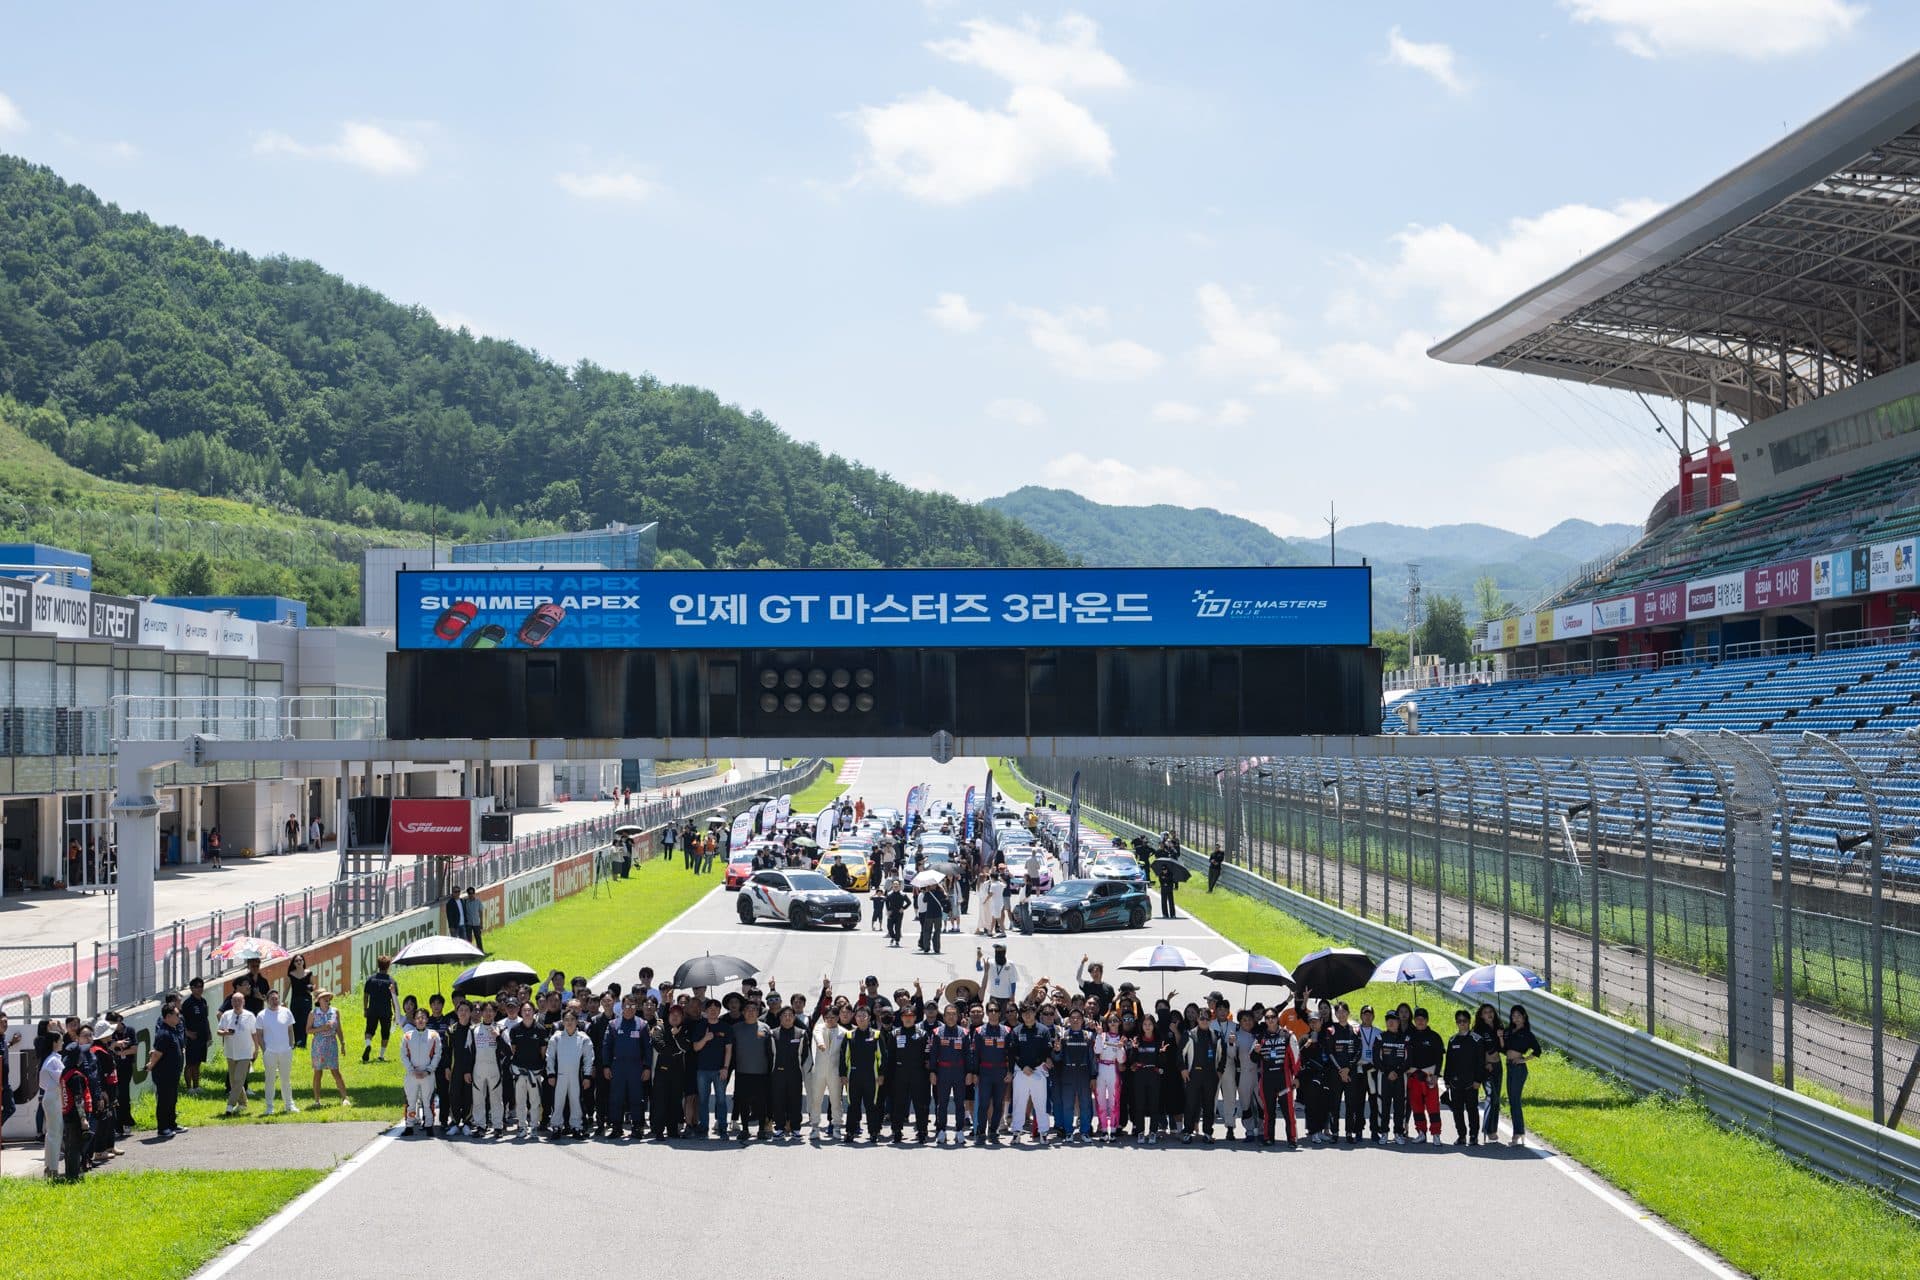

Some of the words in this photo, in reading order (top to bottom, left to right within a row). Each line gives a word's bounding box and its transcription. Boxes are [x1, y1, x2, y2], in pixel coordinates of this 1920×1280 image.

[420, 577, 552, 592] SUMMER
[560, 577, 641, 591] APEX
[1717, 581, 1743, 607] 태영건설
[1776, 568, 1799, 597] 데시앙
[0, 585, 27, 624] BT
[35, 595, 52, 621] RBT
[53, 597, 87, 626] MOTORS
[560, 596, 641, 610] APEX
[668, 593, 747, 625] 인제
[759, 594, 820, 624] GT
[829, 593, 991, 625] 마스터즈
[1001, 592, 1153, 625] 3라운드
[1232, 600, 1254, 609] GT
[1255, 600, 1328, 609] MASTERS
[106, 604, 135, 638] RBT
[407, 822, 463, 833] SPEEDIUM
